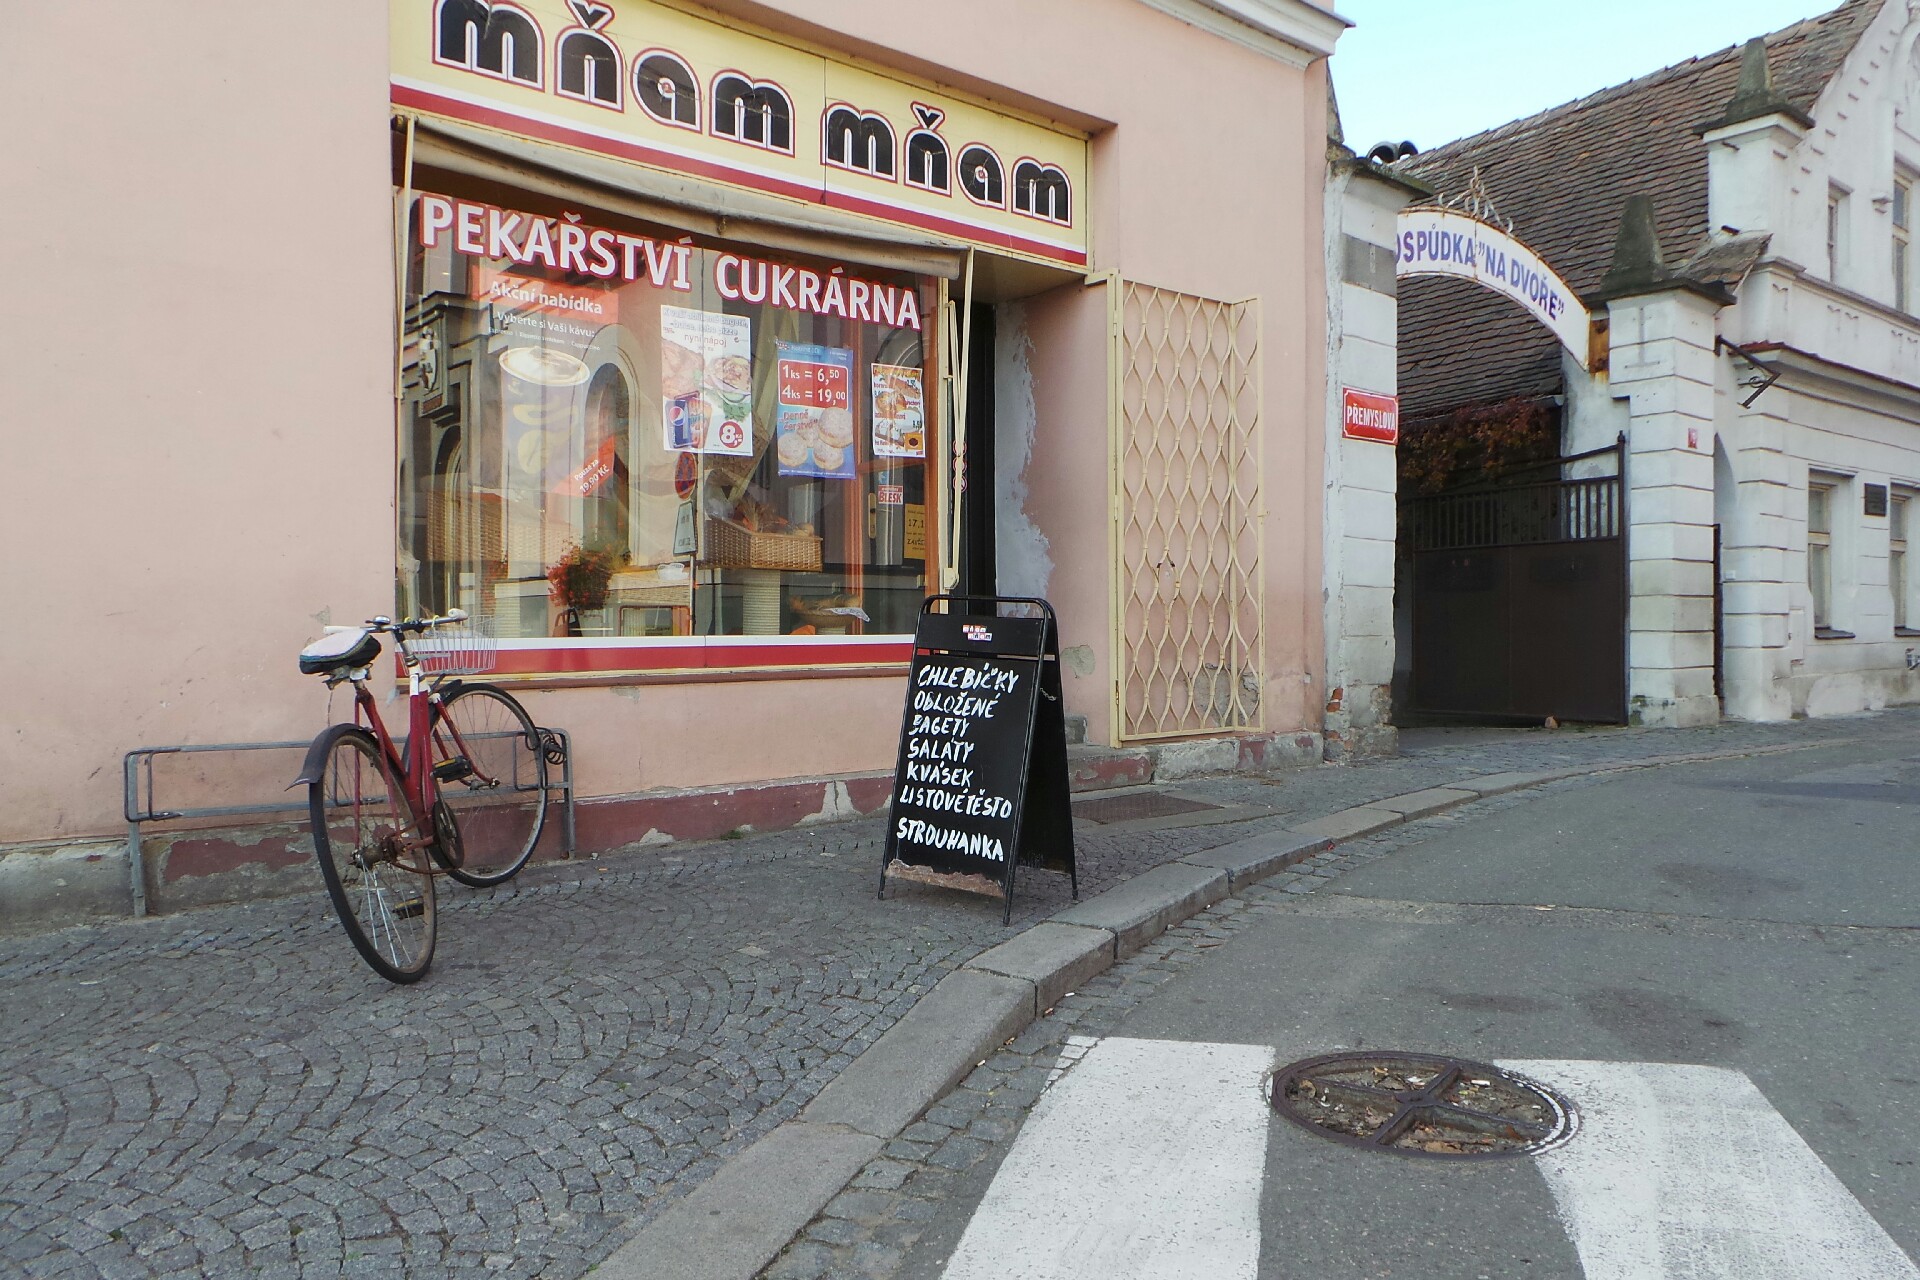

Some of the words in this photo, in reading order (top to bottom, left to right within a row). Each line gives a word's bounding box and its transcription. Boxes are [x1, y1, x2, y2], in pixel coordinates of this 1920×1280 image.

[820, 101, 1073, 228] mňam
[421, 195, 693, 290] PEKAŘSTVÍ
[715, 255, 921, 331] CUKRÁRNA
[490, 281, 536, 303] Akční
[538, 293, 603, 315] nabídka
[497, 311, 537, 328] Vyberte
[539, 319, 546, 329] si
[547, 320, 567, 334] Vaši
[568, 325, 596, 338] kávu:
[783, 364, 800, 379] 1ks
[781, 384, 801, 399] 4ks
[1346, 403, 1396, 430] PŘEMYSLOVA
[918, 662, 1020, 694] CHLEBÍČKY
[914, 690, 1001, 718] OBLOŽENÉ
[908, 714, 970, 737] BAGETY
[907, 737, 975, 763] SALÁTY
[906, 760, 974, 788] KVÁSEK
[896, 817, 1004, 862] STROUHANKA
